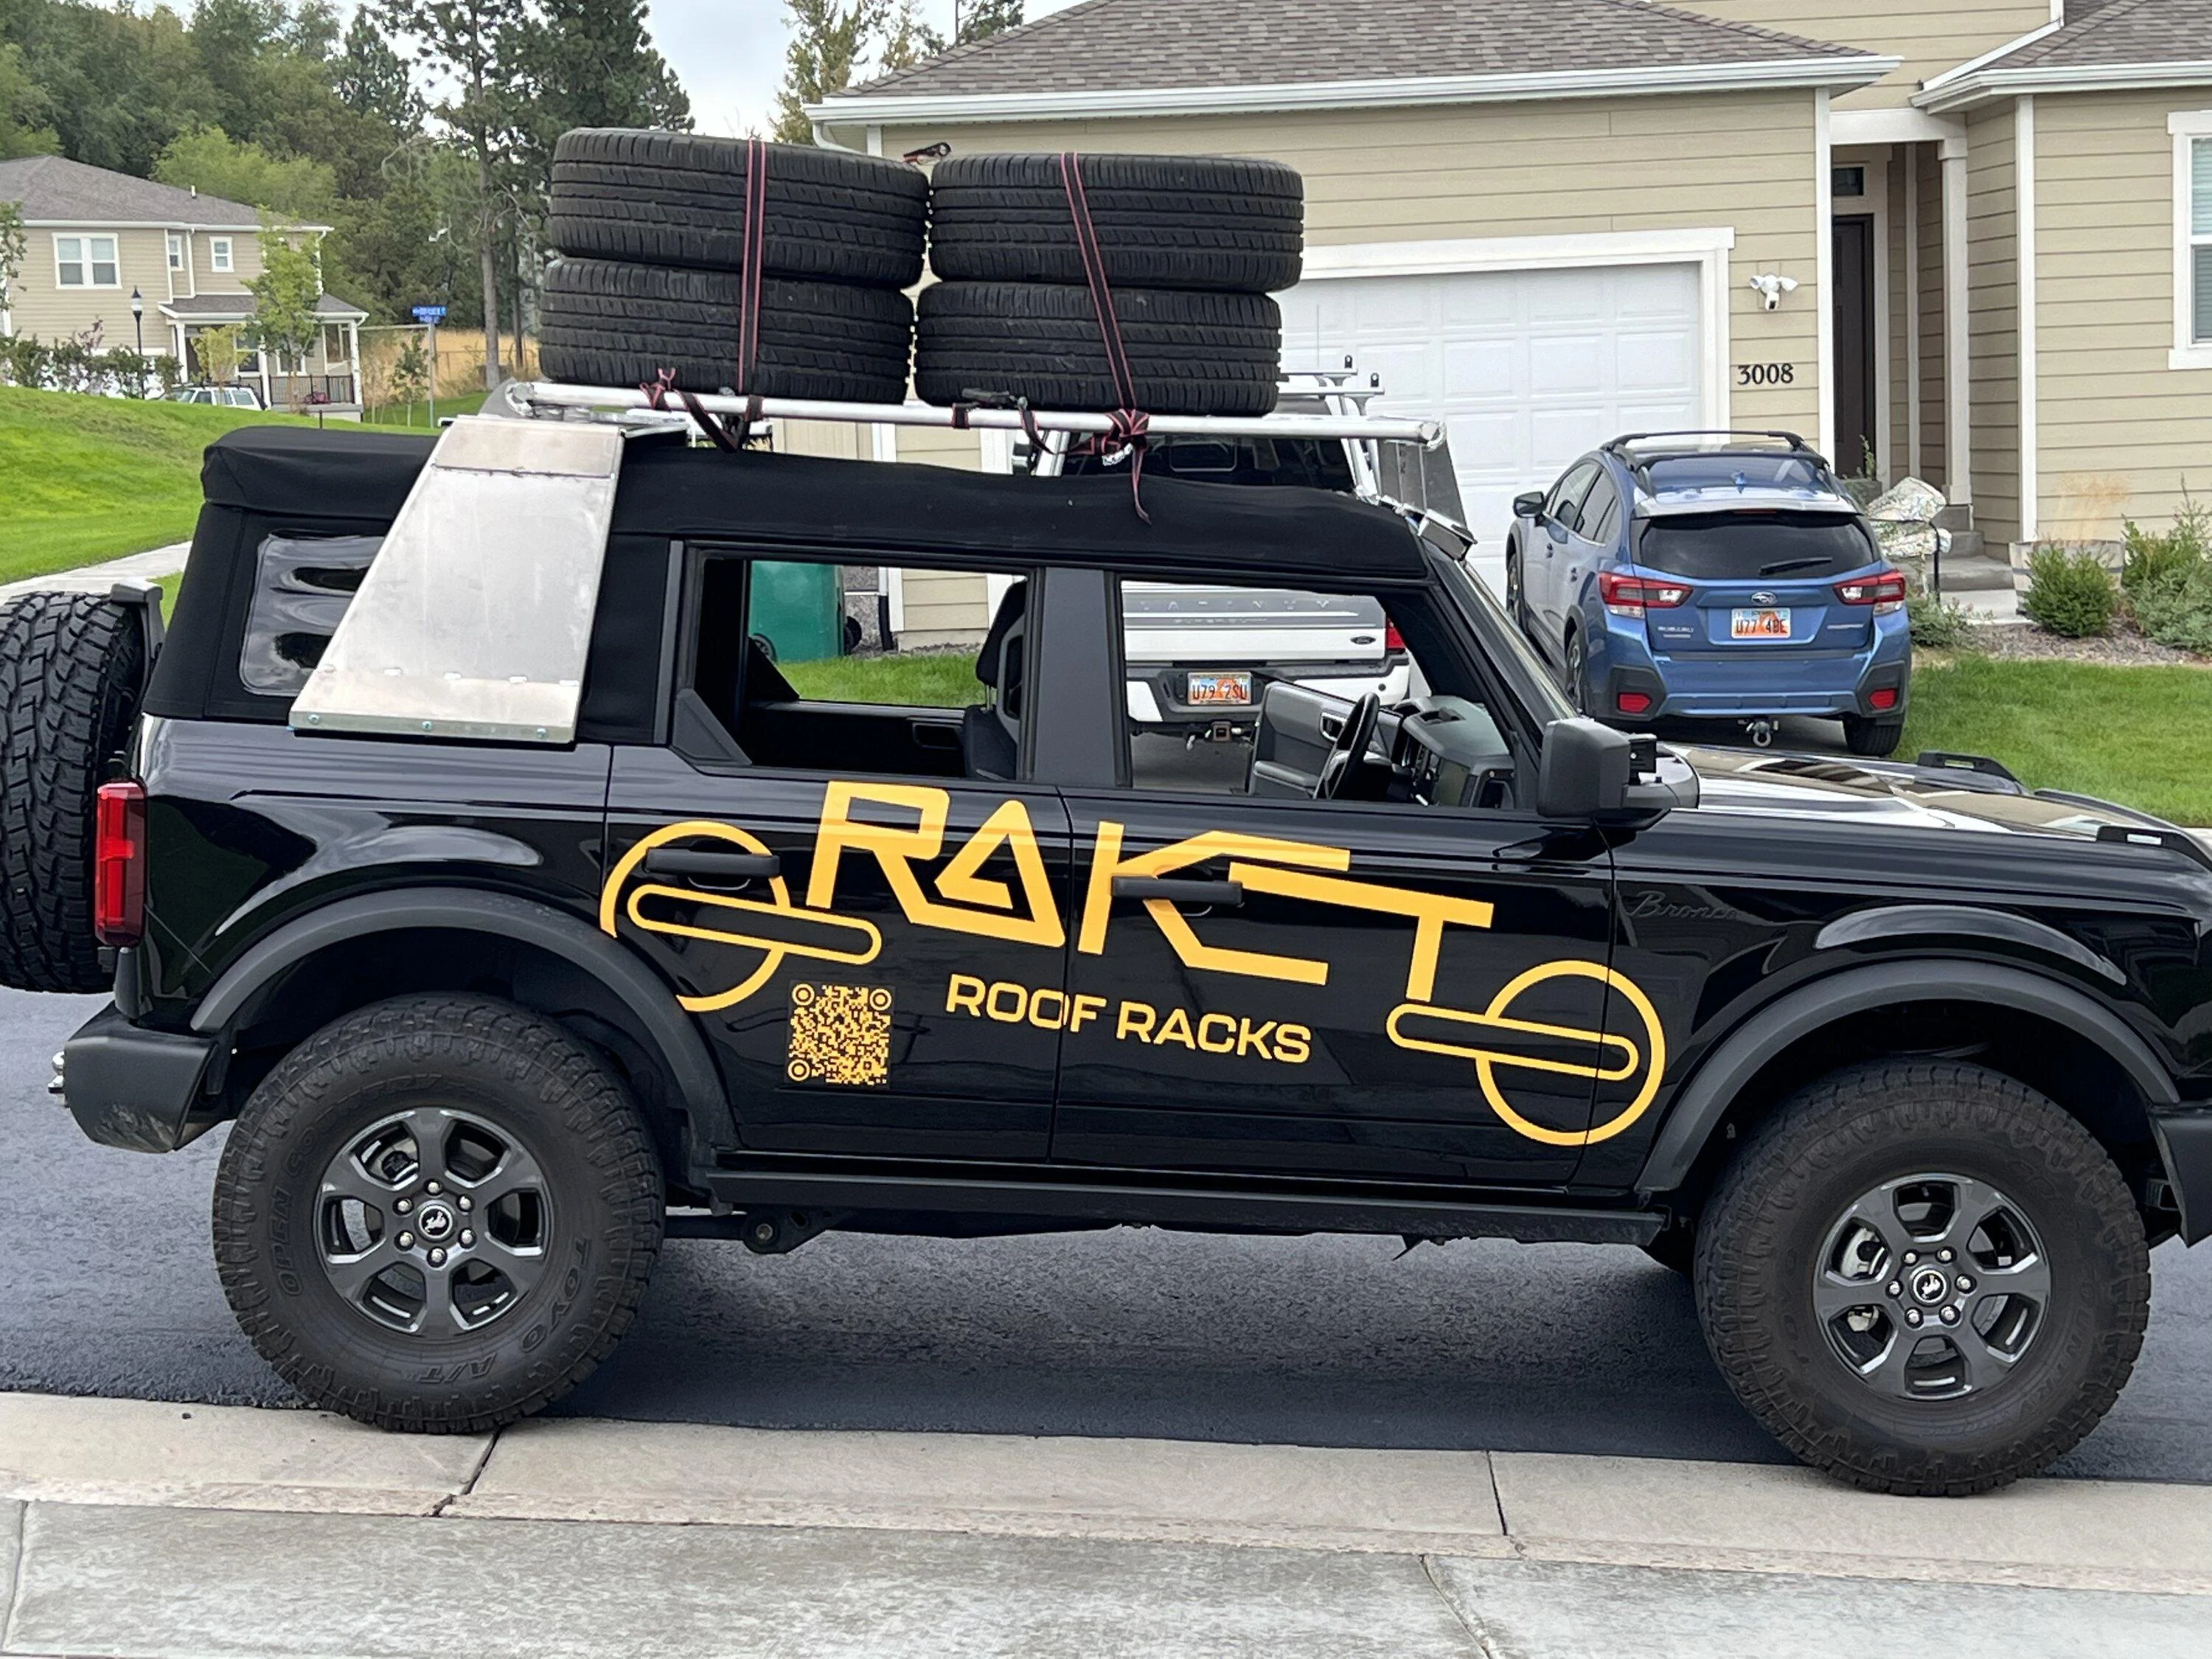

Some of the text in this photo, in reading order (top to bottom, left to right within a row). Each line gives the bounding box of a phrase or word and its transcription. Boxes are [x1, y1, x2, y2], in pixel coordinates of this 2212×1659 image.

[1736, 363, 1793, 386] 3008
[1192, 684, 1216, 700] U79
[1624, 890, 1738, 919] Bronco
[946, 973, 1312, 1064] ROOF RACKS
[268, 1185, 302, 1297] OPEN
[521, 1237, 591, 1353] TOYO
